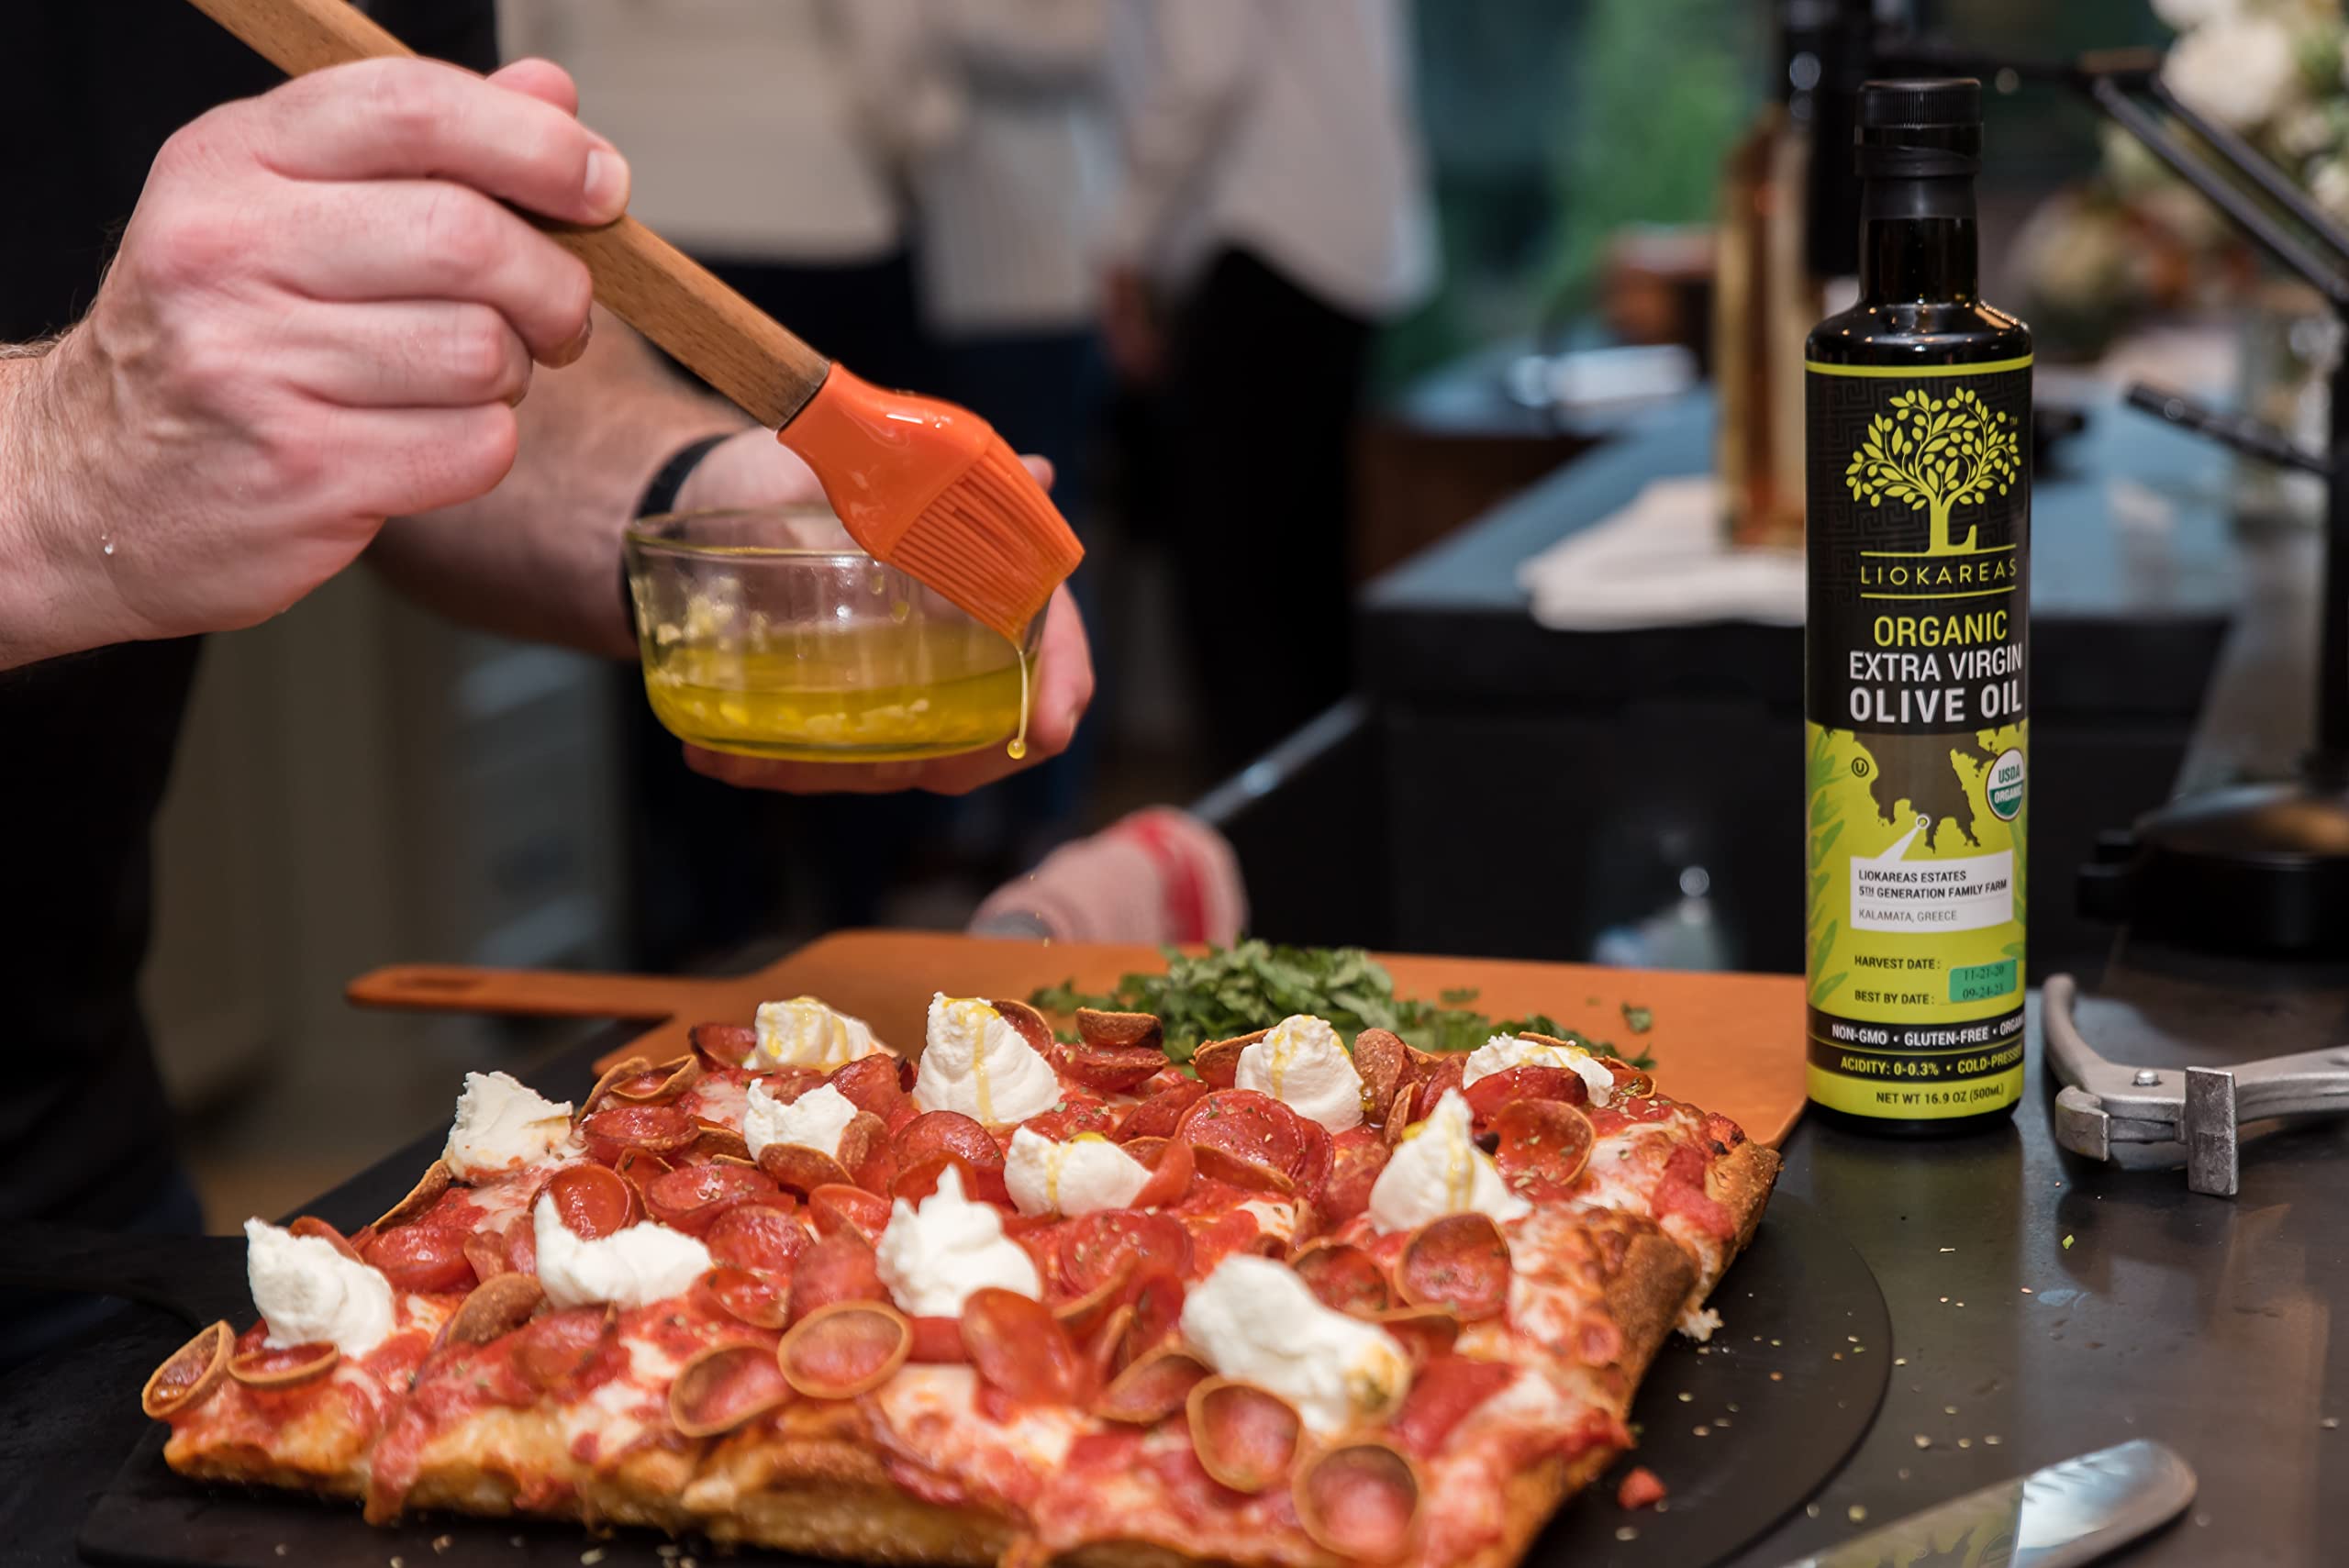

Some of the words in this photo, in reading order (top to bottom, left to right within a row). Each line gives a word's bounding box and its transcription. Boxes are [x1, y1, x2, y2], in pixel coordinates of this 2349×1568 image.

[1861, 558, 2017, 585] LIOKAREAS
[1874, 609, 2008, 647] ORGANIC
[1850, 651, 1941, 683] EXTRA
[1948, 642, 2022, 681] VIRGIN
[1850, 686, 1965, 723] OLIVE
[1980, 680, 2022, 719] OIL
[1998, 764, 2021, 784] USDA
[1858, 869, 1918, 883] LIOKAREAS
[1920, 871, 1966, 884] ESTATES
[1859, 885, 1875, 896] 5TH
[1876, 886, 1945, 899] GENERATION
[1948, 884, 1983, 898] FAMILY
[1985, 879, 2008, 894] FARM
[1858, 908, 1915, 923] KALAMATA,
[1917, 909, 1957, 922] GREECE
[1854, 955, 1904, 970] HARVEST
[1854, 990, 1880, 1004] BEST
[1883, 992, 1898, 1005] BY
[1831, 1023, 1888, 1046] NON-GMO
[1904, 1025, 1989, 1047] GLUTEN-FREE
[1841, 1055, 1890, 1075] ACIDITY:
[1893, 1063, 1939, 1076] 0-0.3%
[1876, 1092, 1901, 1105] NET
[1902, 1093, 1921, 1105] WT
[1925, 1092, 1950, 1105] 16.9
[1952, 1090, 1967, 1103] OZ
